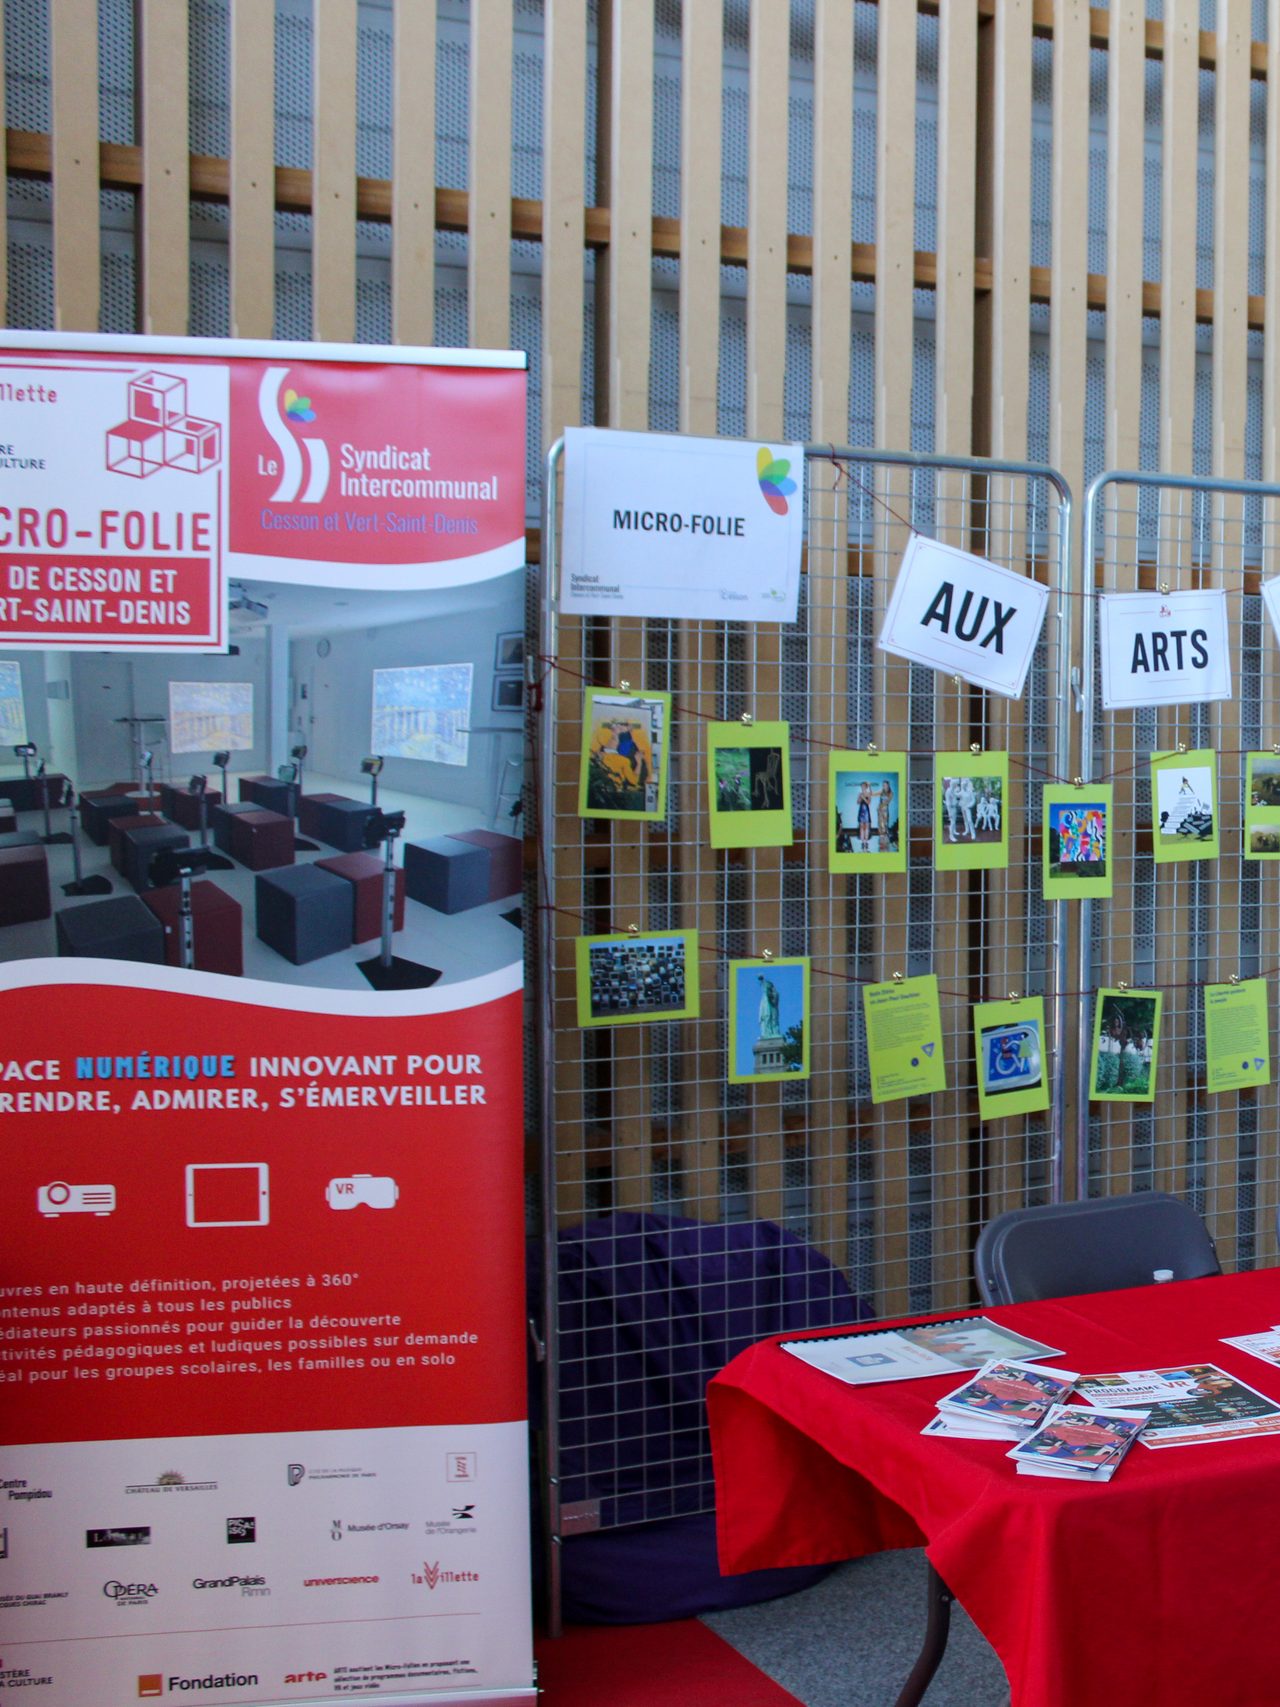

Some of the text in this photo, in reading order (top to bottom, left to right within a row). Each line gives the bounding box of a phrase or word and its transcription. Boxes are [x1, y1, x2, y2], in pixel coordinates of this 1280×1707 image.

[259, 455, 278, 475] Le
[341, 443, 431, 472] Syndicat
[341, 473, 498, 500] Intercommunal
[261, 509, 478, 534] Cesson et Vert-Saint-Denis
[613, 509, 746, 537] MICRO-FOLIE
[9, 566, 178, 593] DE CESSON ET
[921, 581, 1017, 655] AUX
[1131, 629, 1209, 674] ARTS
[0, 1051, 482, 1081] ACE NUMÉRIQUE INNOVANT POUR
[0, 1081, 487, 1114] RENDRE, ADMIRER, S’ÉMERVEILLER
[336, 1183, 354, 1194] VR
[49, 1284, 69, 1295] en
[75, 1281, 124, 1295] haute
[130, 1278, 216, 1293] définition,
[222, 1275, 300, 1292] projetées
[306, 1275, 316, 1287] à
[322, 1273, 359, 1287] 360°
[0, 1297, 292, 1318] ntenus adaptés à tous les publics
[83, 1320, 181, 1338] passionnés
[186, 1321, 224, 1335] pour
[230, 1318, 283, 1334] guider
[289, 1317, 303, 1329] la
[309, 1314, 401, 1328] découverte
[63, 1343, 183, 1360] pédagogiques
[188, 1342, 205, 1354] et
[211, 1339, 282, 1354] ludiques
[289, 1336, 368, 1352] possibles
[373, 1336, 399, 1347] sur
[405, 1331, 479, 1346] demande
[29, 1370, 68, 1384] pour
[74, 1367, 99, 1379] les
[105, 1364, 174, 1380] groupes
[180, 1361, 262, 1375] scolaires,
[268, 1359, 292, 1371] les
[299, 1356, 365, 1370] familles
[370, 1357, 391, 1367] ou
[396, 1355, 415, 1366] en
[420, 1352, 456, 1366] solo
[1084, 1380, 1191, 1394] PROGRAMME VR
[8, 1490, 52, 1501] Pompidou
[193, 1576, 266, 1590] GrandPalais
[303, 1575, 380, 1587] universcience
[8, 1676, 53, 1687] CULTURE
[169, 1673, 258, 1691] Fondation
[284, 1671, 327, 1684] arte
